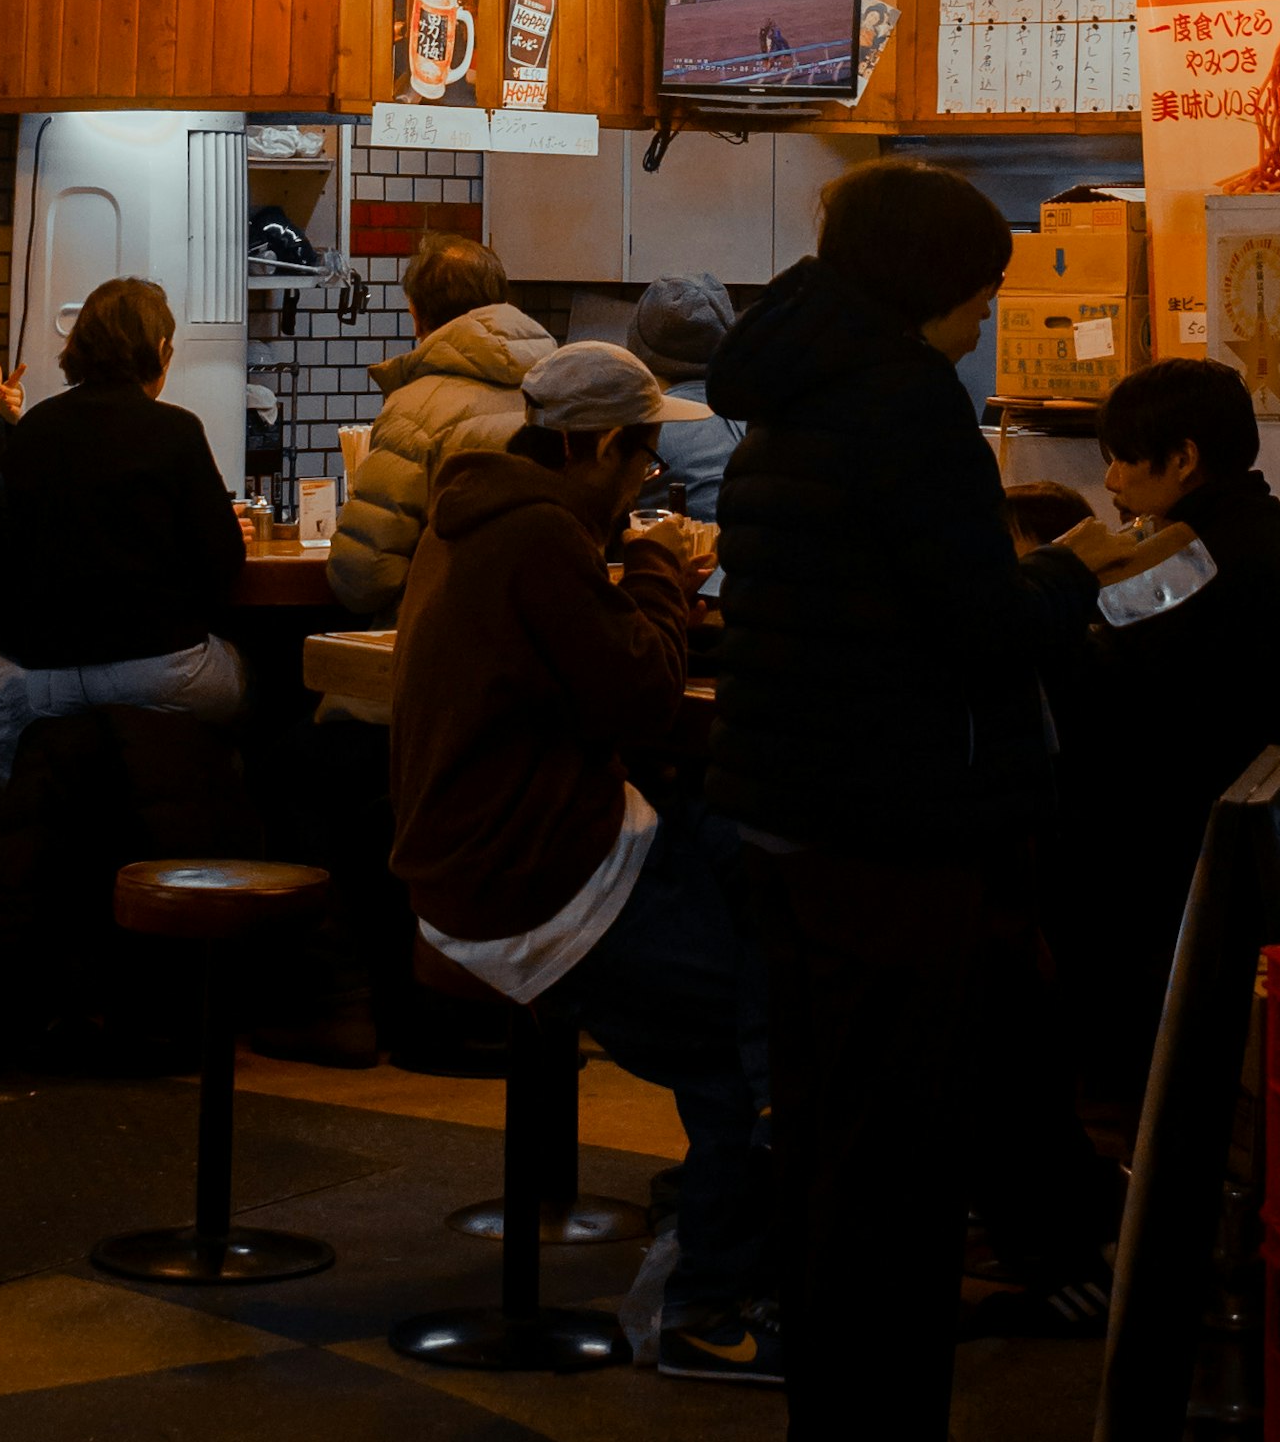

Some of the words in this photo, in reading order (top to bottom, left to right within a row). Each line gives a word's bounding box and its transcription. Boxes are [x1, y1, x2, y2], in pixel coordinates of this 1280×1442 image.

[1148, 8, 1273, 43] 一度食べたら
[1185, 46, 1258, 77] やみつき
[1168, 296, 1207, 311] 生ビー
